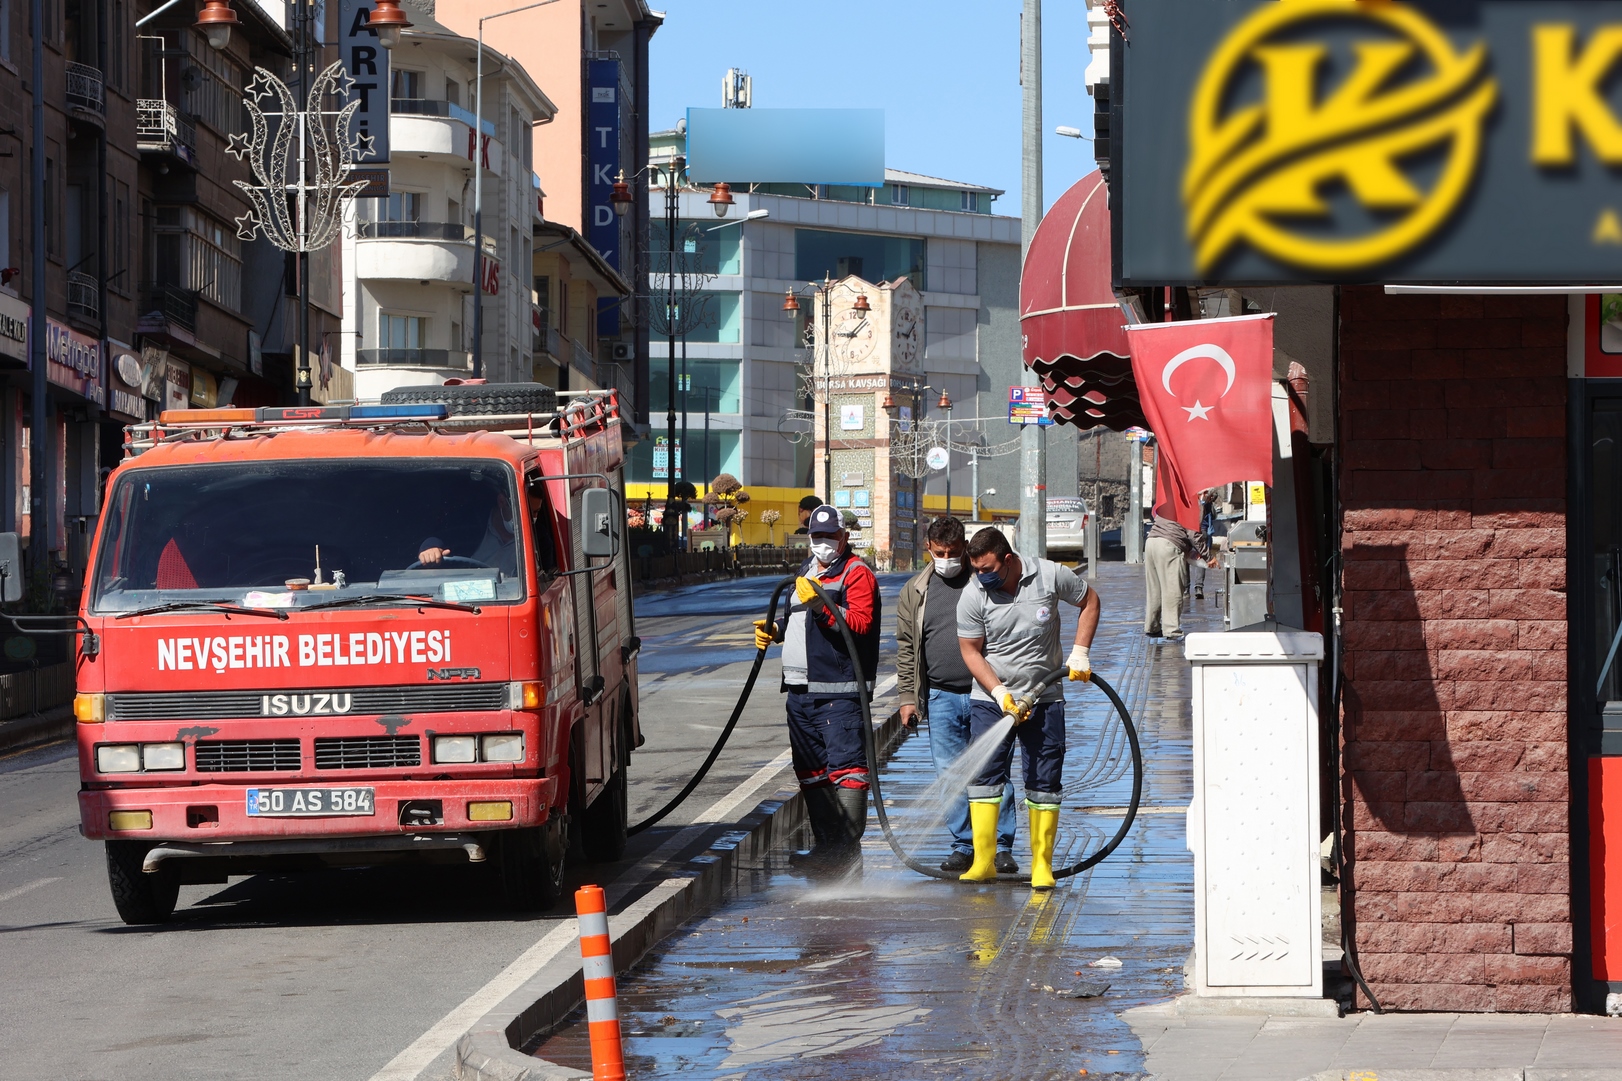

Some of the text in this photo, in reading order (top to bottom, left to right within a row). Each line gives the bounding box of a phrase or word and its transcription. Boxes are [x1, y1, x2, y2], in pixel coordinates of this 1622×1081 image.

[849, 376, 887, 390] KAVŞAĞI
[1013, 389, 1021, 399] P
[282, 408, 321, 419] CSR
[427, 668, 481, 680] NPR
[262, 693, 351, 715] ISUZU
[258, 789, 370, 812] 50 AS 584
